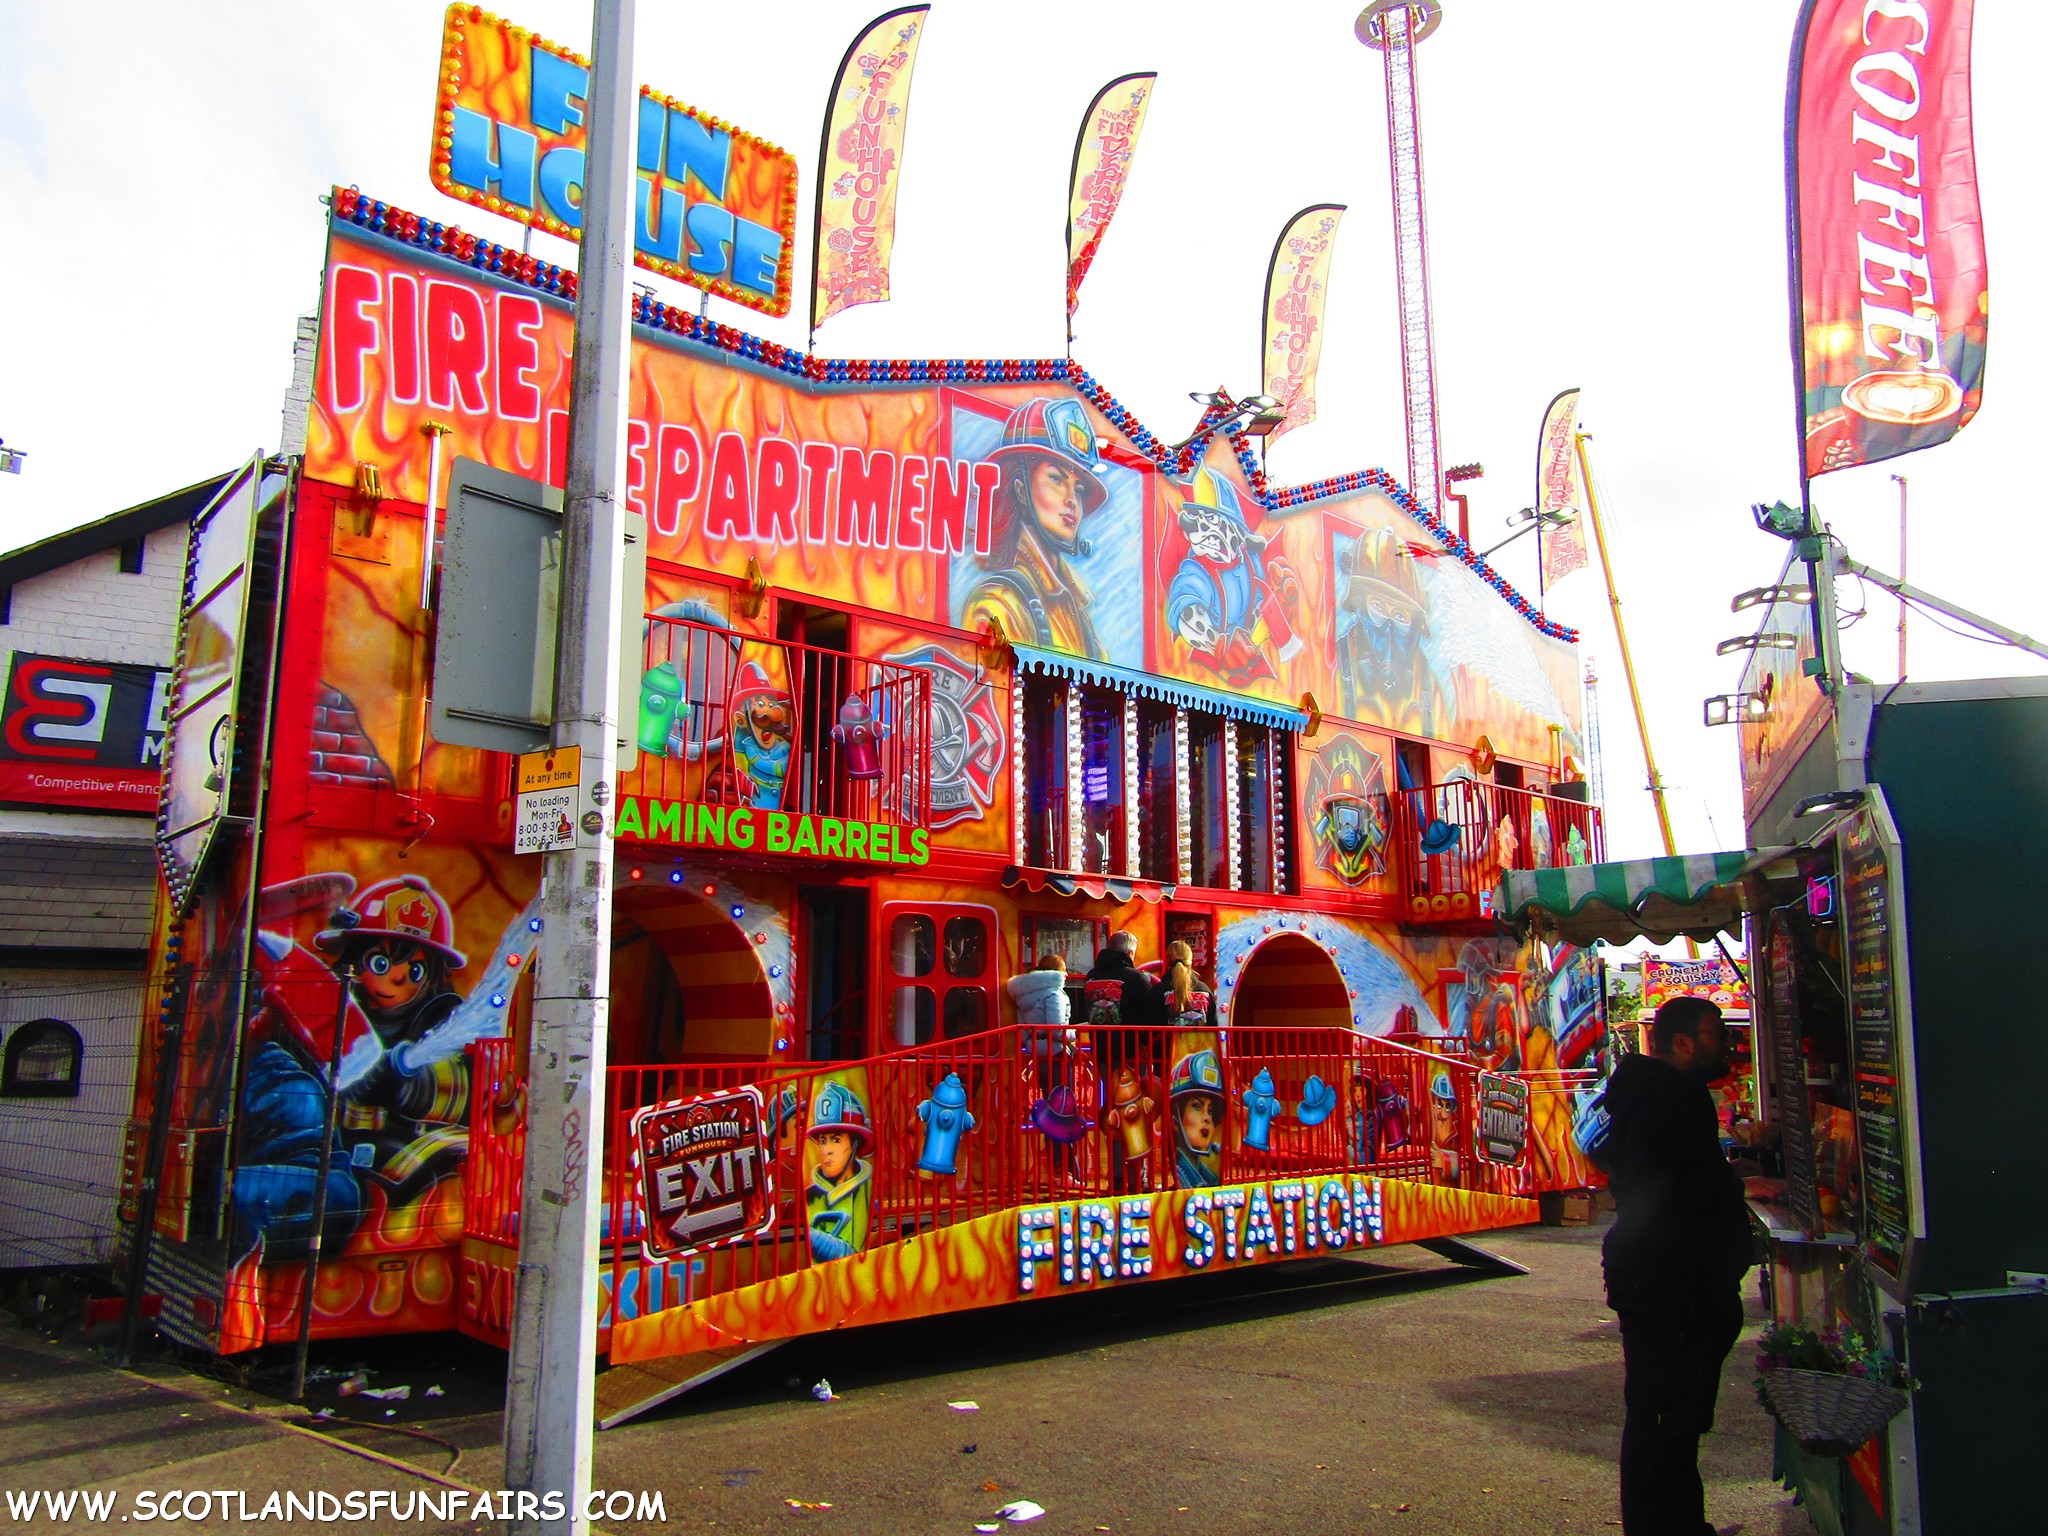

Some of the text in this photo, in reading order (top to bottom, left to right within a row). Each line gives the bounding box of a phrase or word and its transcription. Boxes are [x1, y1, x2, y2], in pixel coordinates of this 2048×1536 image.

[857, 53, 909, 72] CRAZY
[1097, 118, 1136, 137] FIRE
[850, 70, 891, 274] FUNHOUSE
[1849, 0, 1943, 370] COFFEE
[1287, 237, 1328, 253] CRAZY
[329, 264, 545, 423] FIRE
[117, 780, 162, 796] Financ
[525, 770, 572, 785] At any time
[526, 795, 570, 809] No loading
[531, 807, 563, 821] Mon-Fri
[614, 797, 930, 866] AMING BARRELS
[1650, 963, 1708, 979] CRUNCHY
[1664, 970, 1718, 986] SQUISHY
[1482, 1106, 1523, 1143] ENTRANCE
[662, 1121, 741, 1158] FIRE STATION
[680, 1139, 727, 1157] FUNHOUSE
[656, 1145, 756, 1213] EXIT
[1018, 1179, 1383, 1293] FIRE STATION
[463, 1256, 512, 1332] EXI
[600, 1258, 705, 1329] XIT
